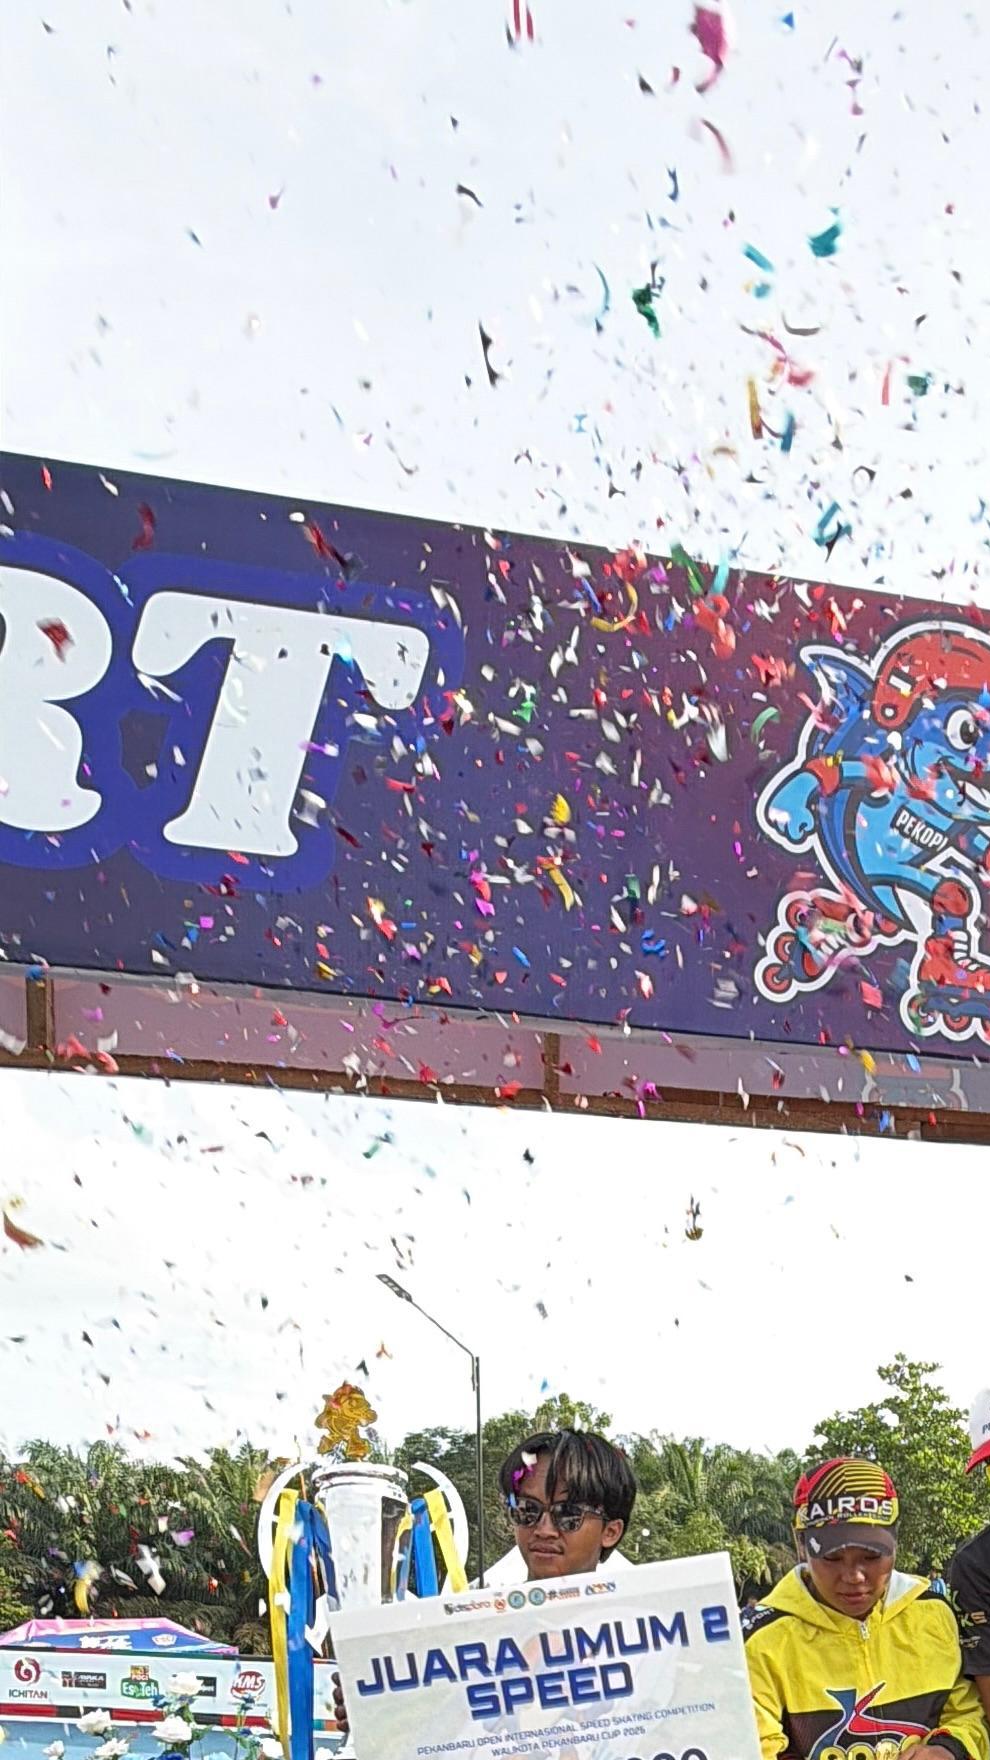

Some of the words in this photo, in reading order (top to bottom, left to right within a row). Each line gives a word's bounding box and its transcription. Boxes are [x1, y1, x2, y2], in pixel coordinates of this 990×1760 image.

[895, 809, 949, 852] PEKOPI
[800, 1496, 893, 1521] KAIROS
[356, 1637, 530, 1696] JUARA
[539, 1611, 690, 1668] UMUM
[701, 1604, 731, 1644] 2
[9, 1689, 48, 1699] ICHITAN
[234, 1674, 265, 1690] KMS
[466, 1661, 634, 1721] SPEED
[417, 1738, 475, 1756] PEKANBARU
[477, 1736, 503, 1747] OPEN
[504, 1724, 577, 1742] INTERNASIONAL
[579, 1718, 612, 1731] SPEED
[612, 1711, 654, 1726] SKATING
[654, 1702, 716, 1719] COMPETITION
[491, 1740, 540, 1757] WALIKOTA
[541, 1732, 600, 1750] PEKANBARU
[601, 1728, 621, 1740] CUP
